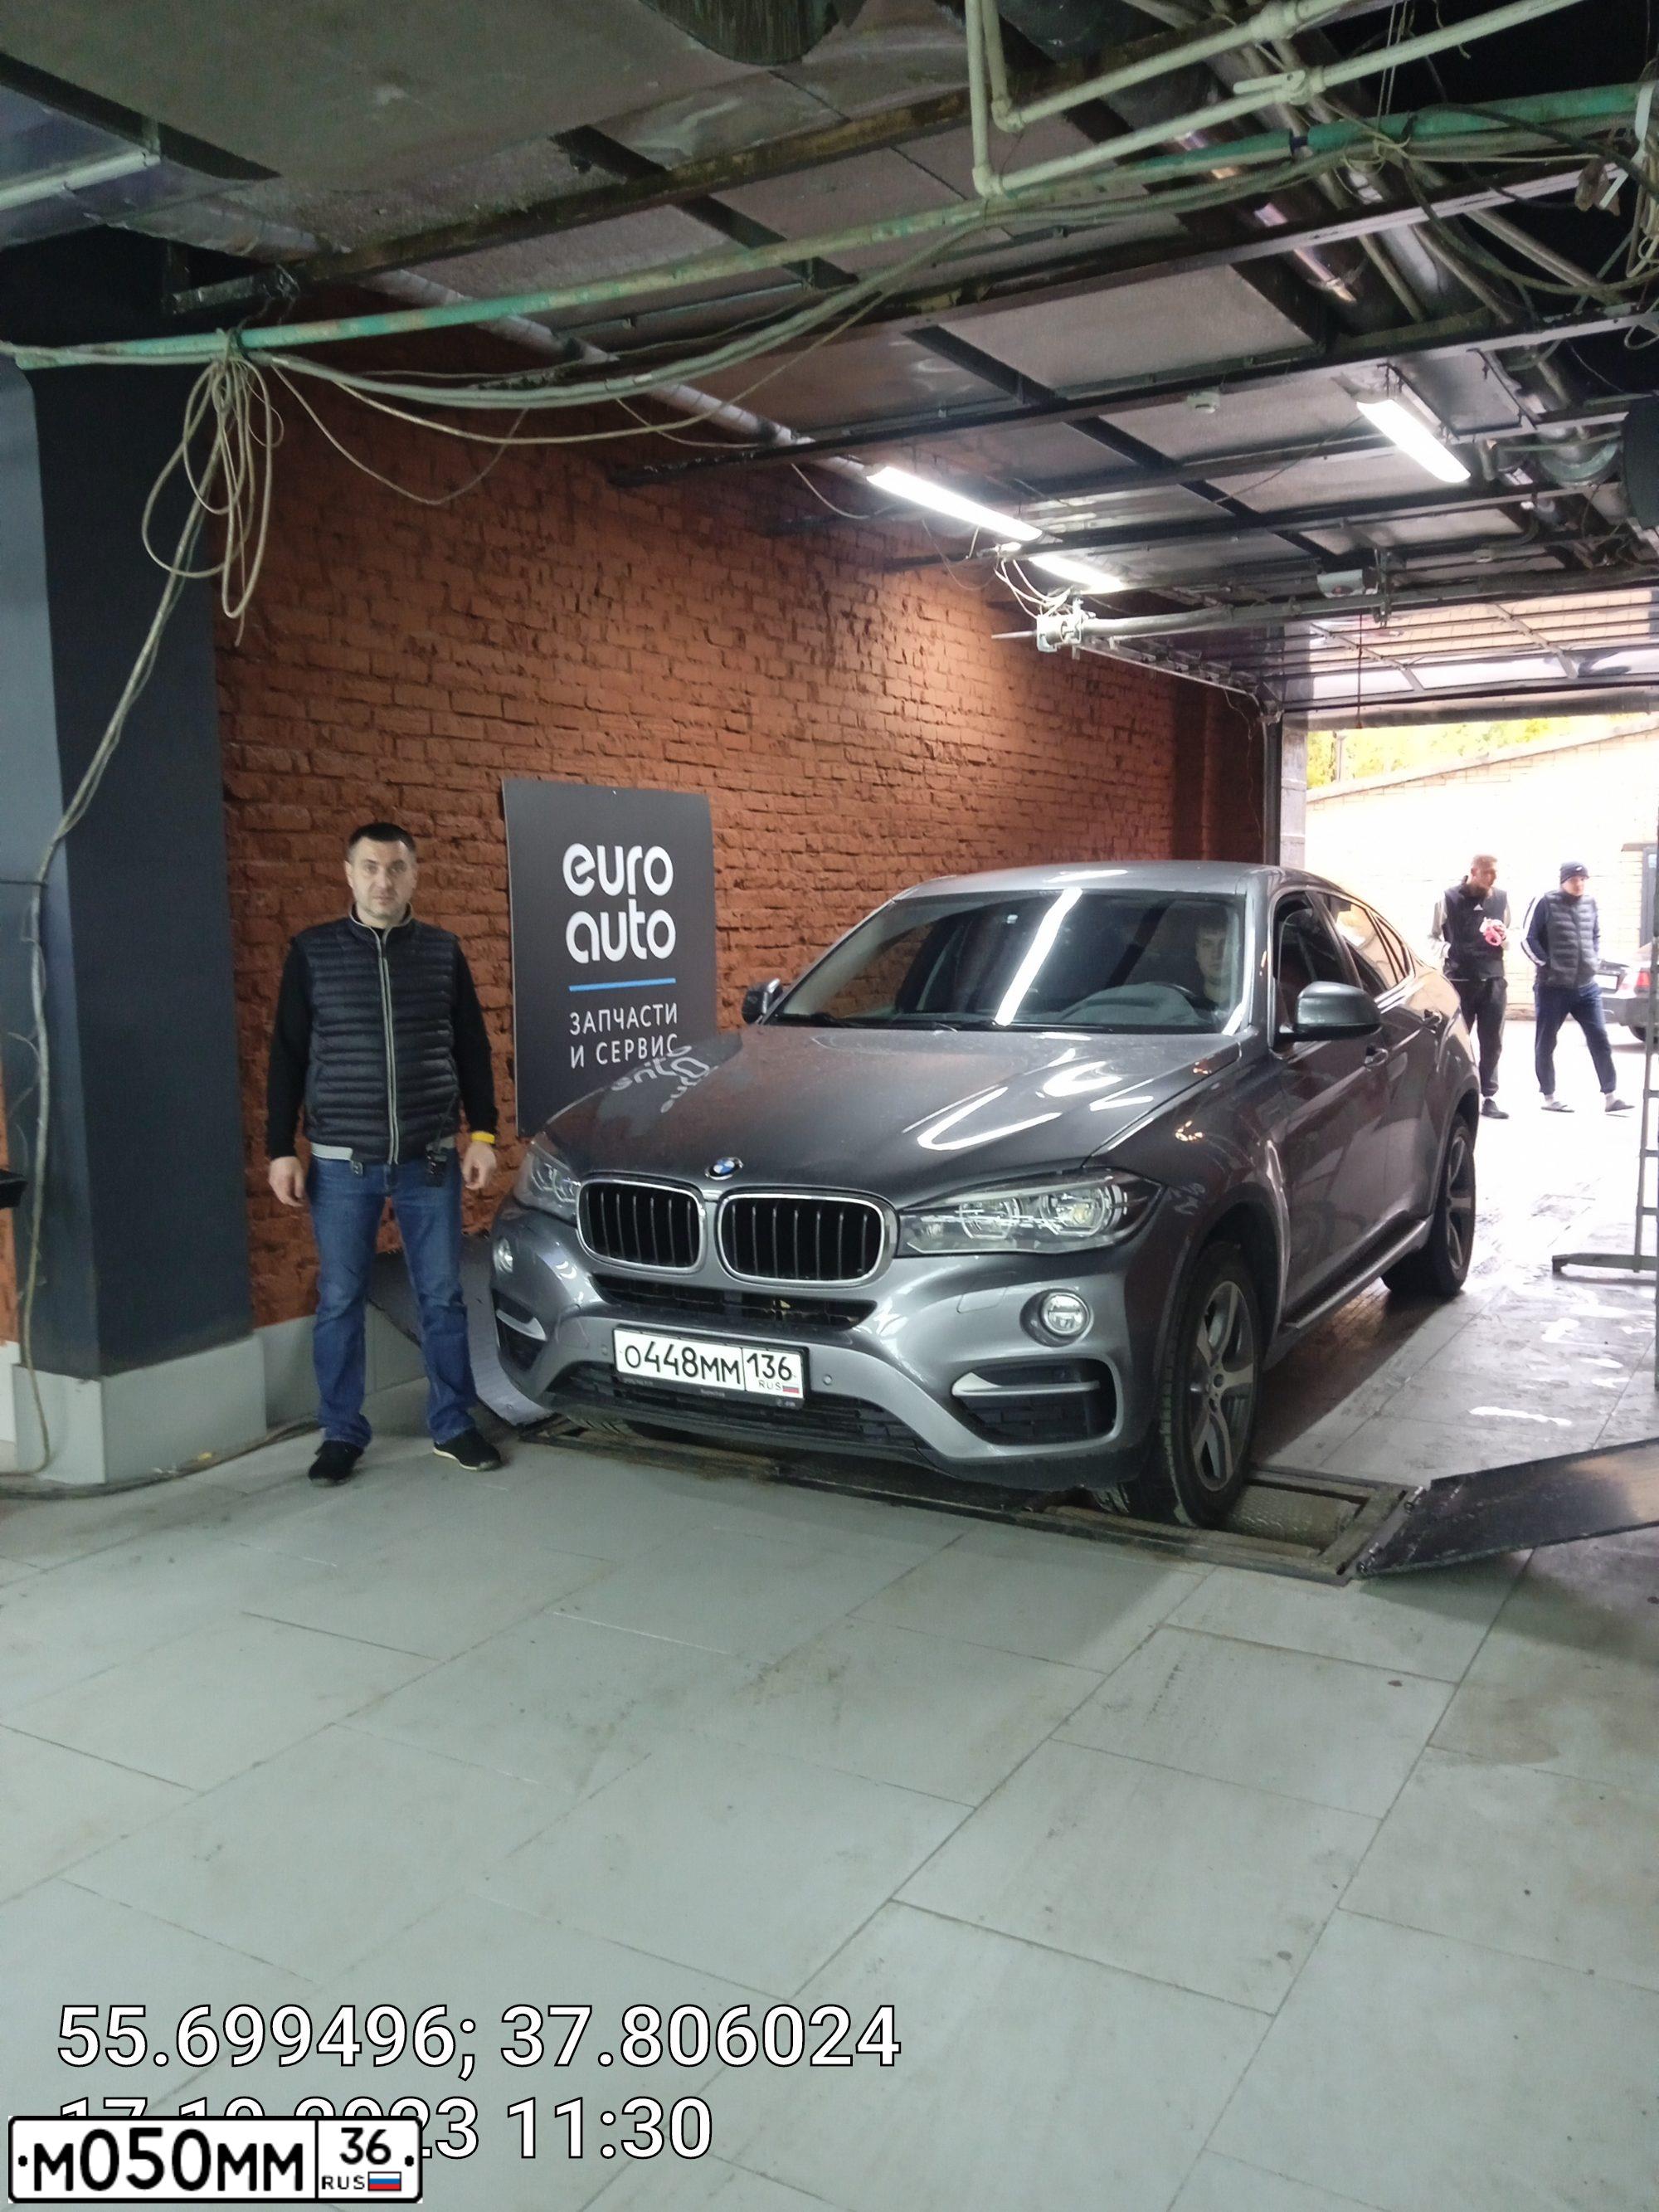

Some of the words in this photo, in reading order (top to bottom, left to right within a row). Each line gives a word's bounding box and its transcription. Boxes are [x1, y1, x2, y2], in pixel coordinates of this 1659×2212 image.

[562, 842, 674, 896] euro
[565, 898, 676, 963] auto
[569, 1002, 678, 1035] ЗАПЧАСТИ
[570, 1045, 585, 1069] И
[596, 1033, 678, 1065] СЕРВИС
[746, 1352, 792, 1381] 136
[758, 1380, 781, 1391] RUS
